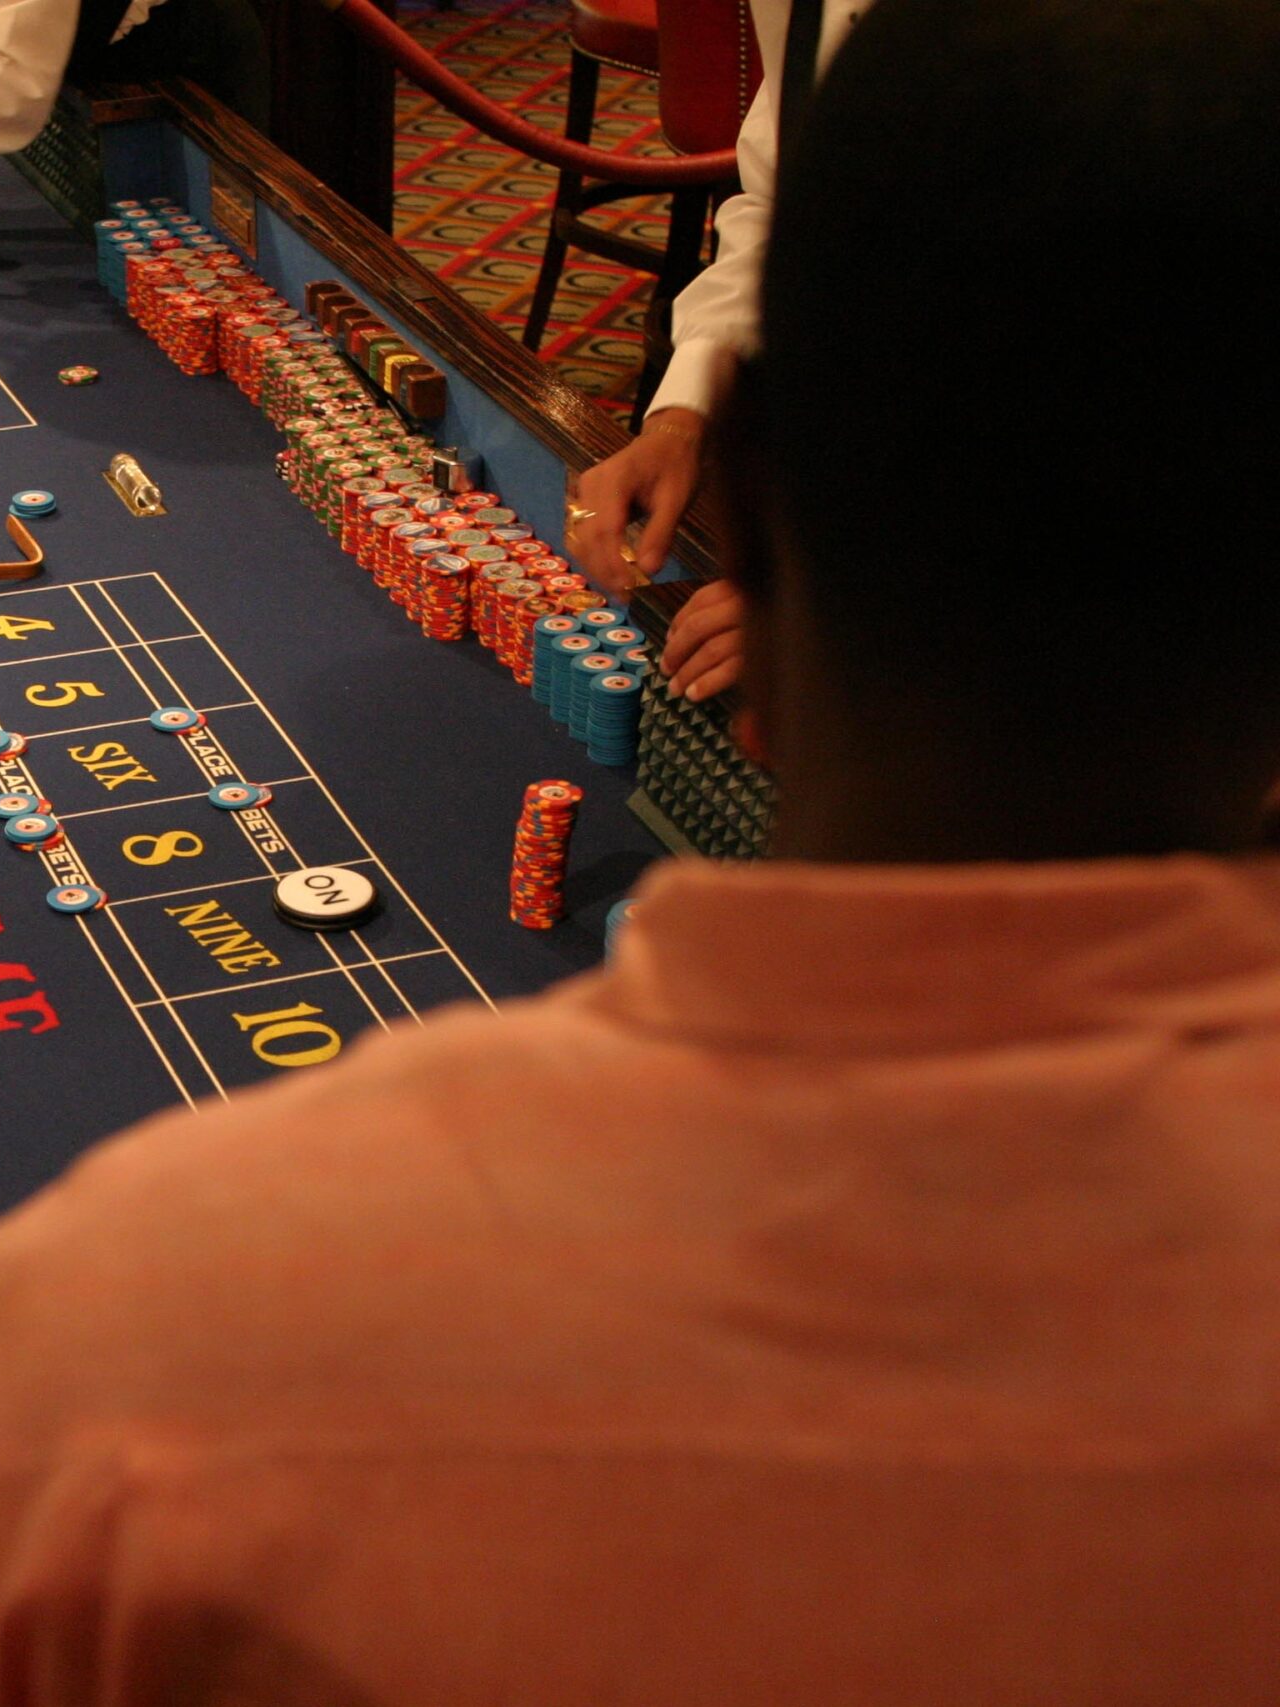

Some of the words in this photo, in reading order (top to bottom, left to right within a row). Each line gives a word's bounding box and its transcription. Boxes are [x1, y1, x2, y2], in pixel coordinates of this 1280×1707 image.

[24, 680, 105, 708] 5
[67, 740, 159, 790] SIX
[123, 830, 203, 866] 8
[239, 809, 286, 854] BETS
[304, 874, 350, 906] ON
[164, 899, 281, 974] NINE
[231, 1001, 342, 1067] 10
